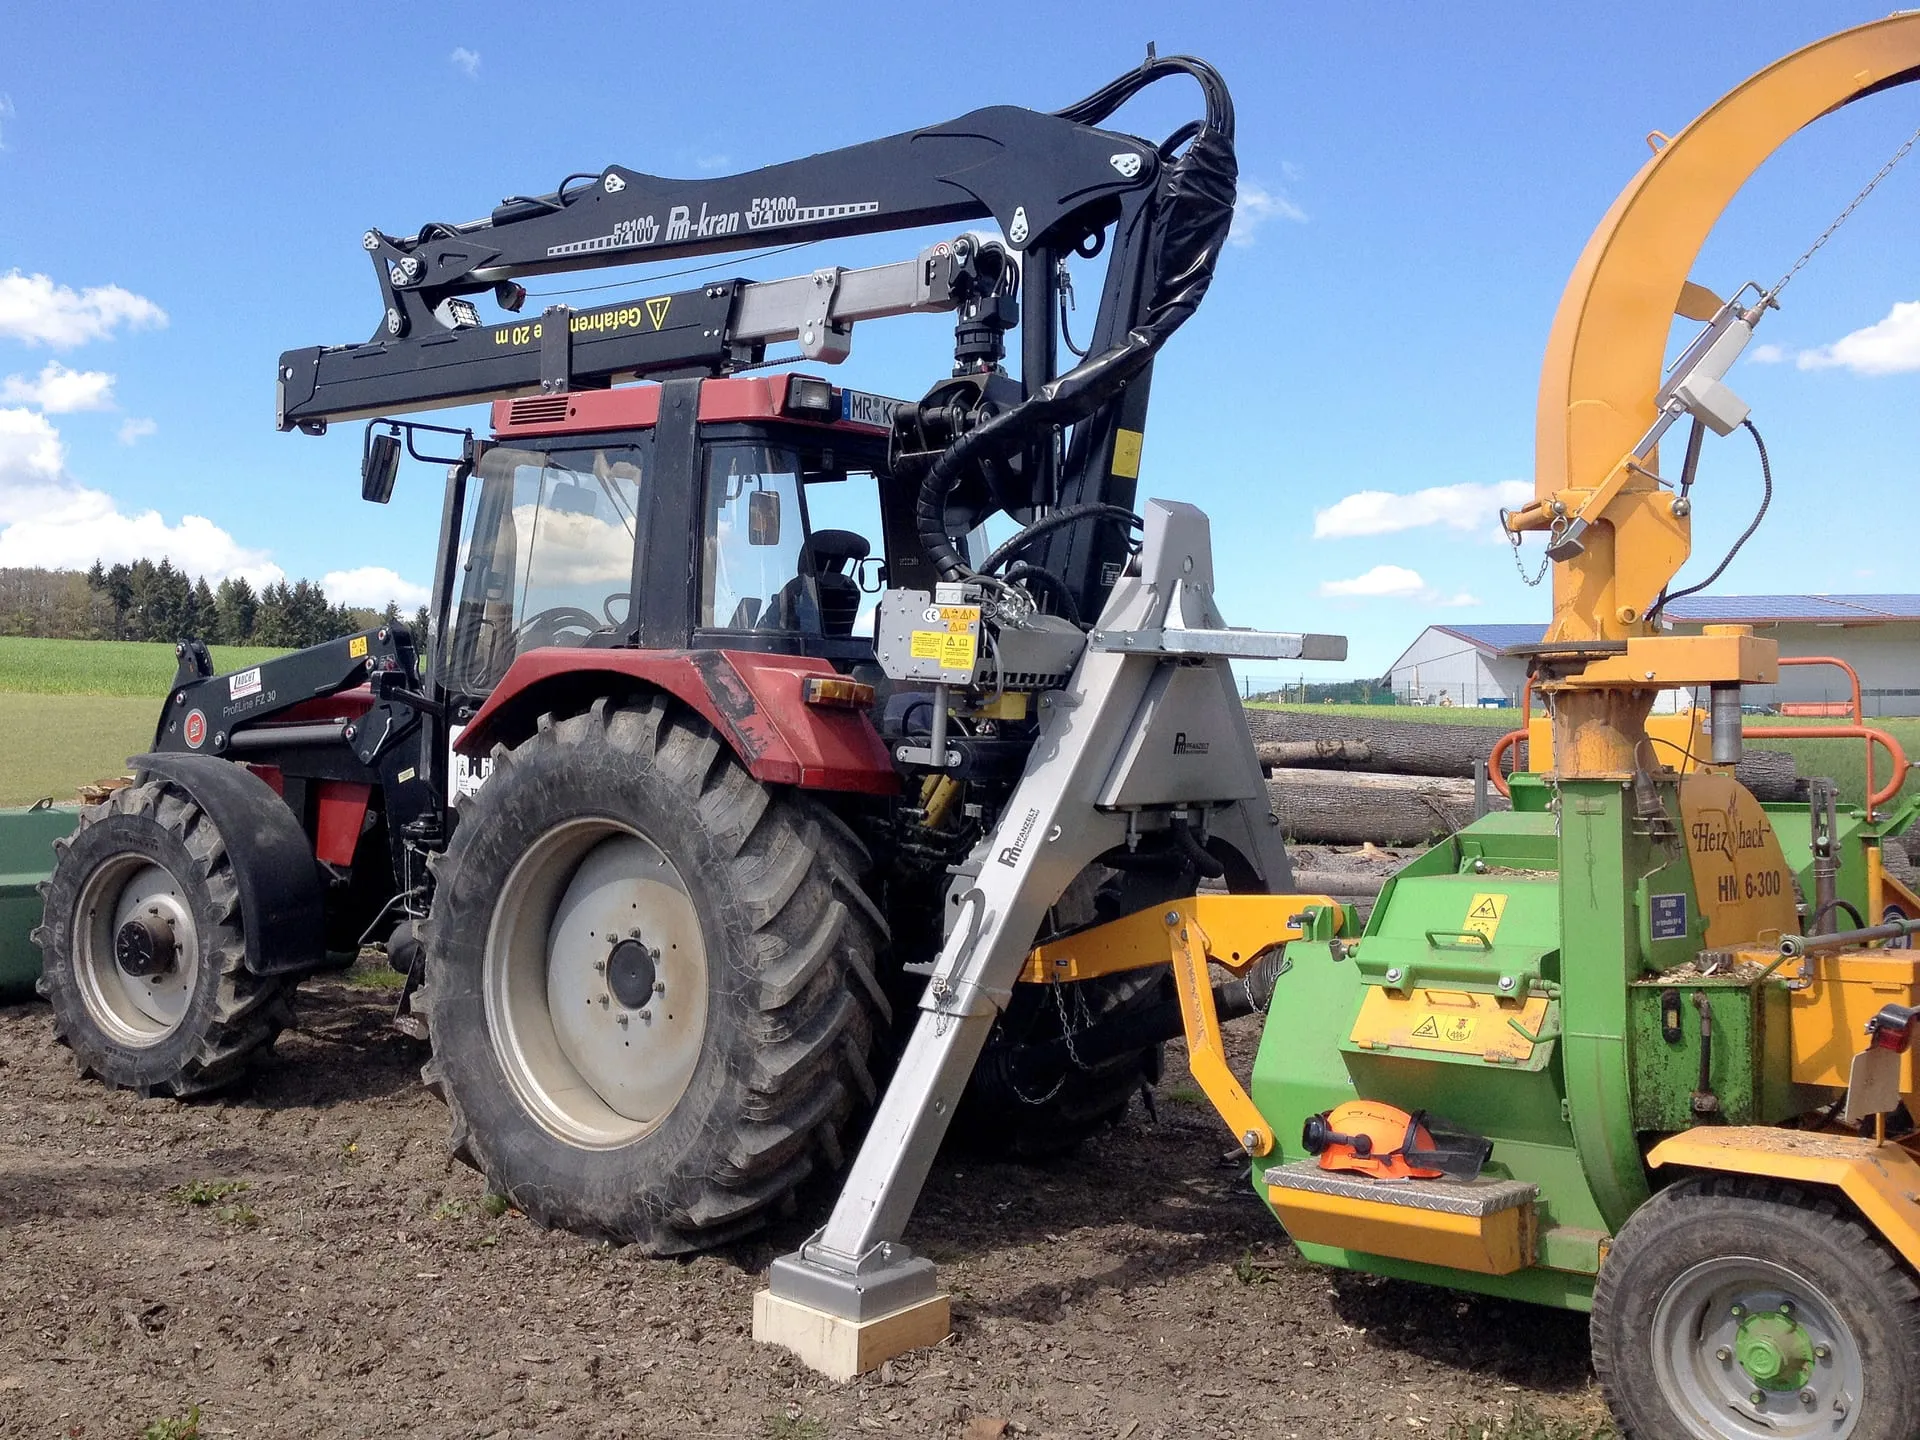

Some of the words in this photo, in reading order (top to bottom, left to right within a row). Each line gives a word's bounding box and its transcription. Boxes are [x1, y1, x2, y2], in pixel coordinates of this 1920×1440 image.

[613, 215, 655, 246] 52100
[750, 196, 798, 226] 52100
[495, 330, 509, 345] m
[512, 326, 530, 346] 20
[852, 394, 872, 421] MR
[925, 610, 937, 621] CE
[255, 693, 266, 706] FZ
[266, 689, 277, 703] 30
